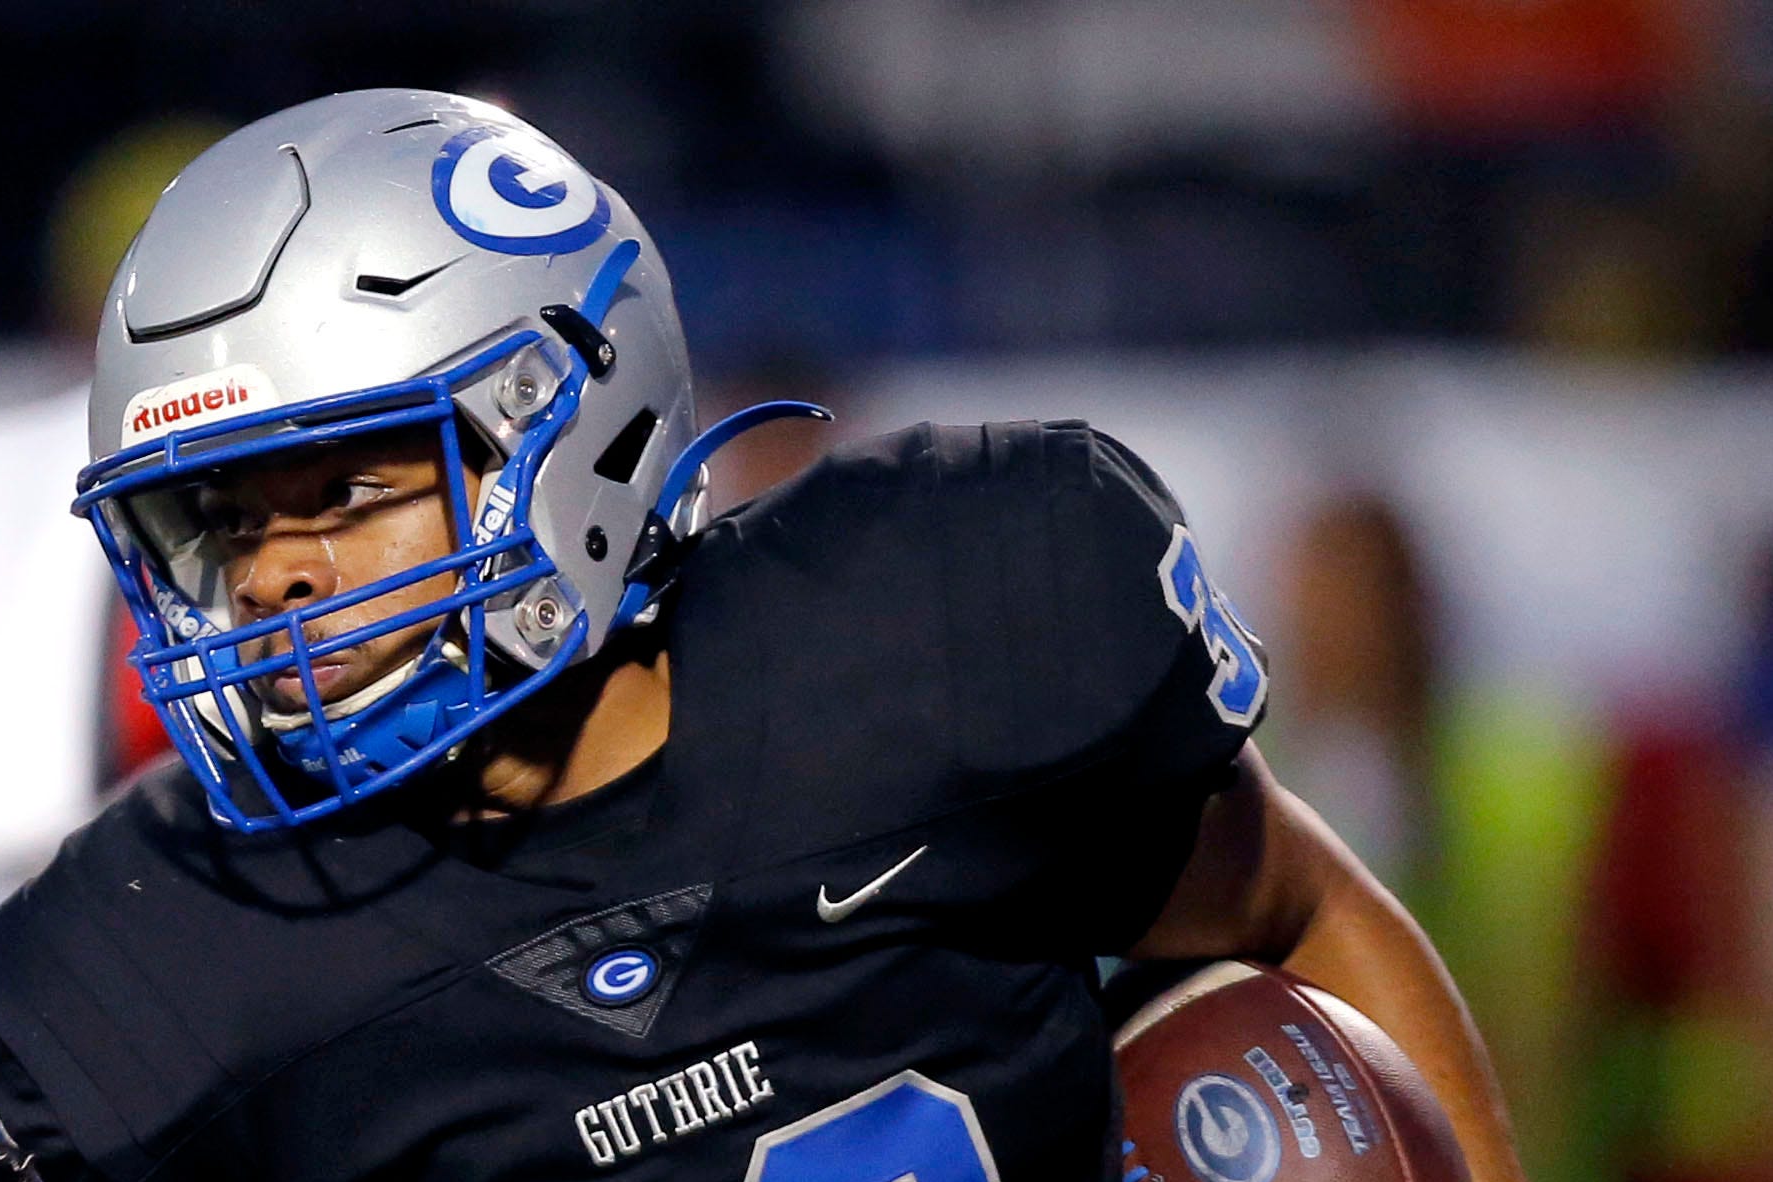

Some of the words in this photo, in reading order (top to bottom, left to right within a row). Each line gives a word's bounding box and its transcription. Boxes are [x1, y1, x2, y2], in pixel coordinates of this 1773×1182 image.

[439, 128, 606, 250] G
[590, 954, 651, 997] G
[574, 1039, 775, 1168] GUTHRIE
